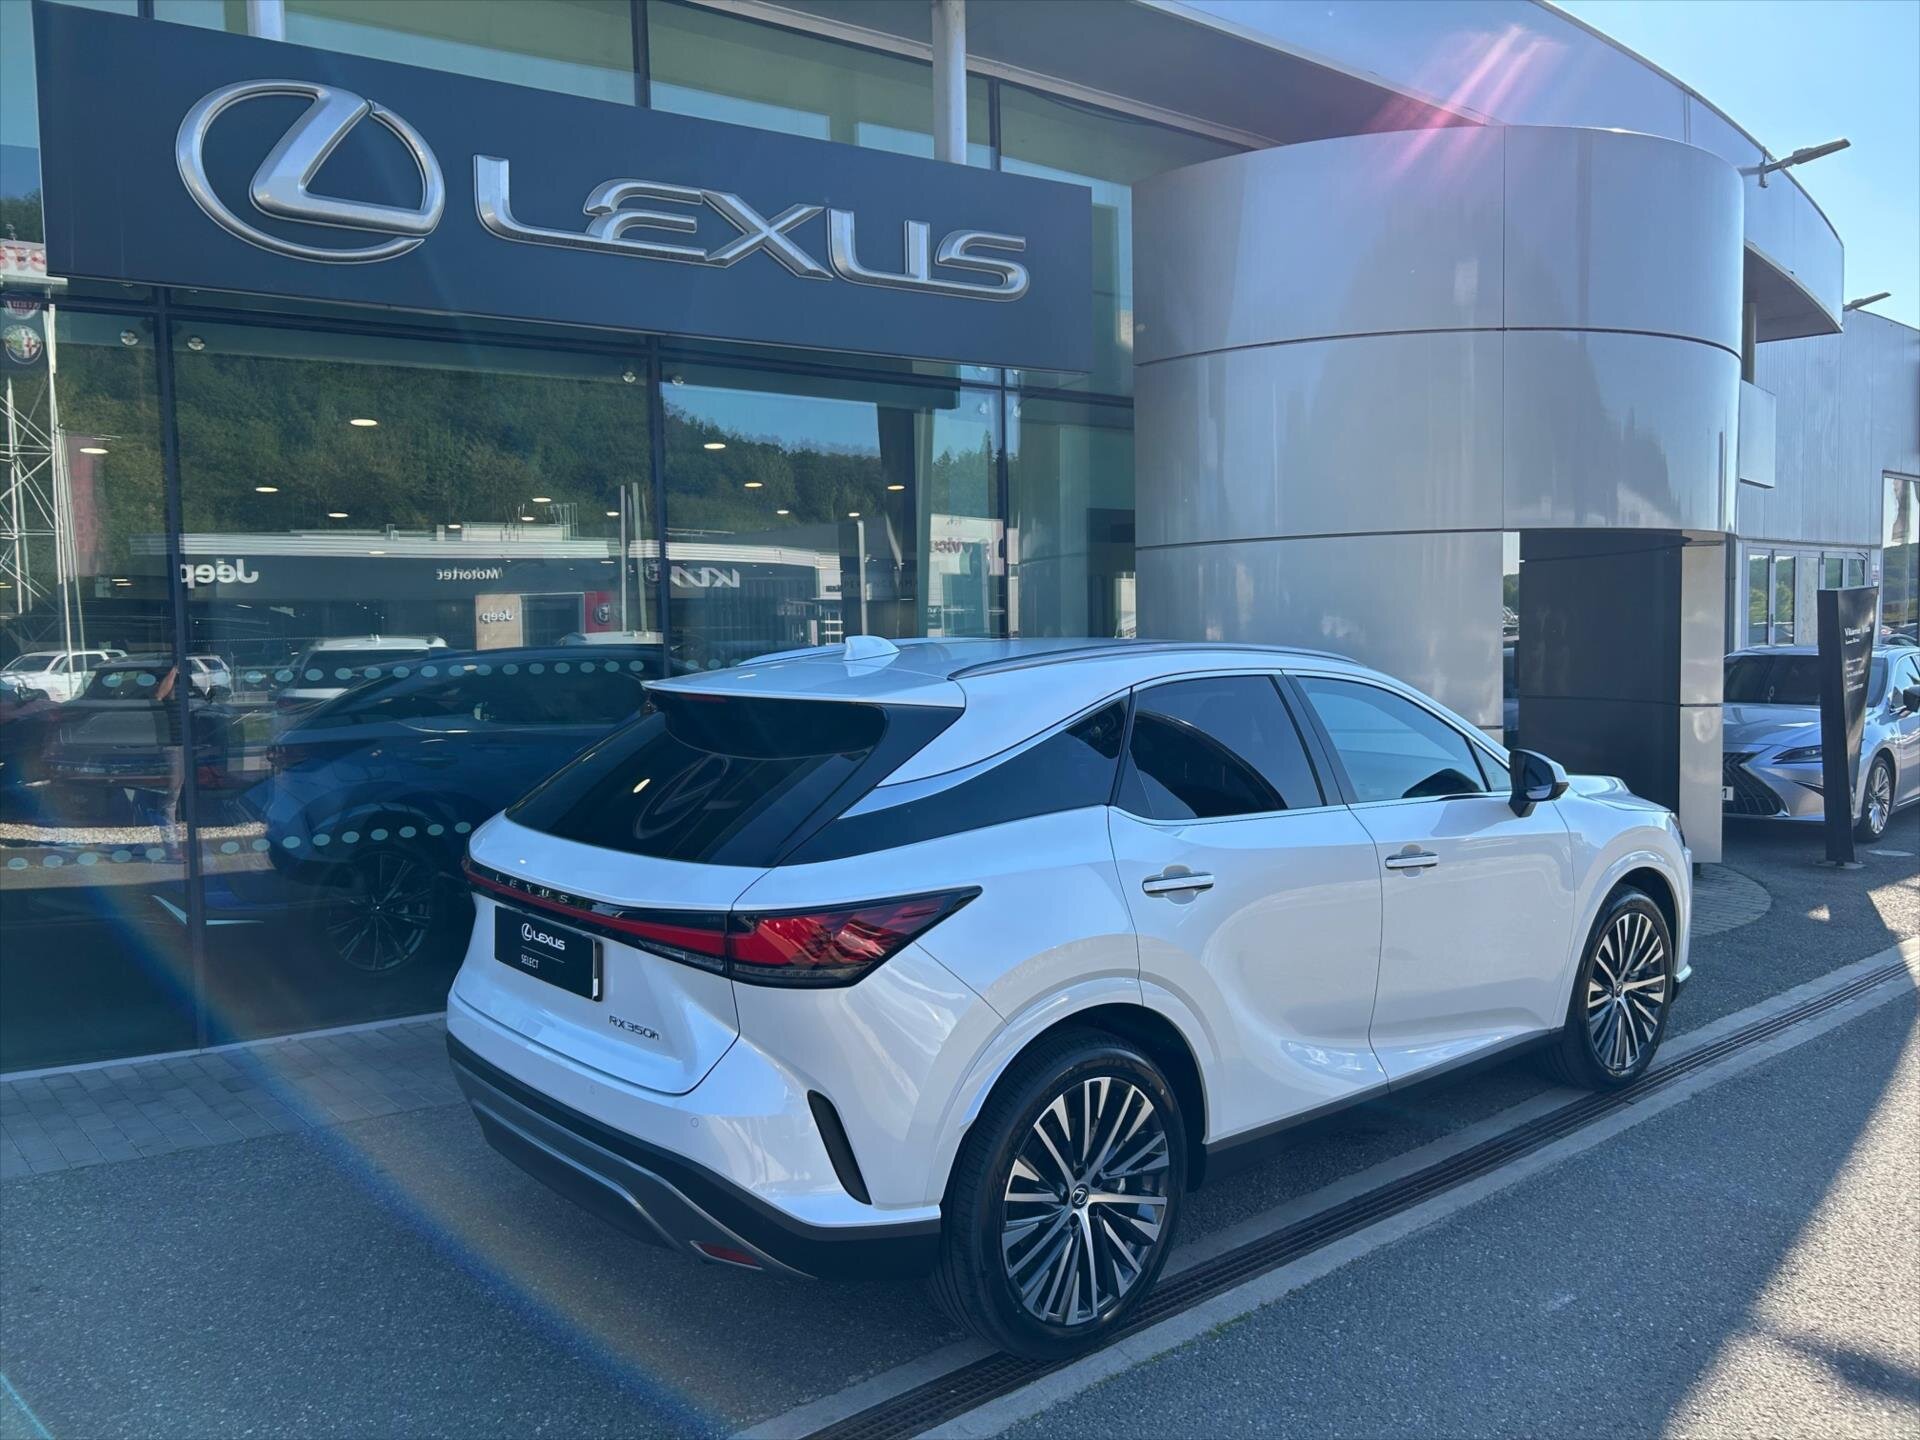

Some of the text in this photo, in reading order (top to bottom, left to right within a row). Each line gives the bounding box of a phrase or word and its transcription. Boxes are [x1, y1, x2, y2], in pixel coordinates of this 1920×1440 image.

[473, 154, 1030, 302] LEXUS
[495, 872, 569, 904] LEXUS
[532, 930, 566, 951] LEXUS
[520, 953, 539, 969] SELECT
